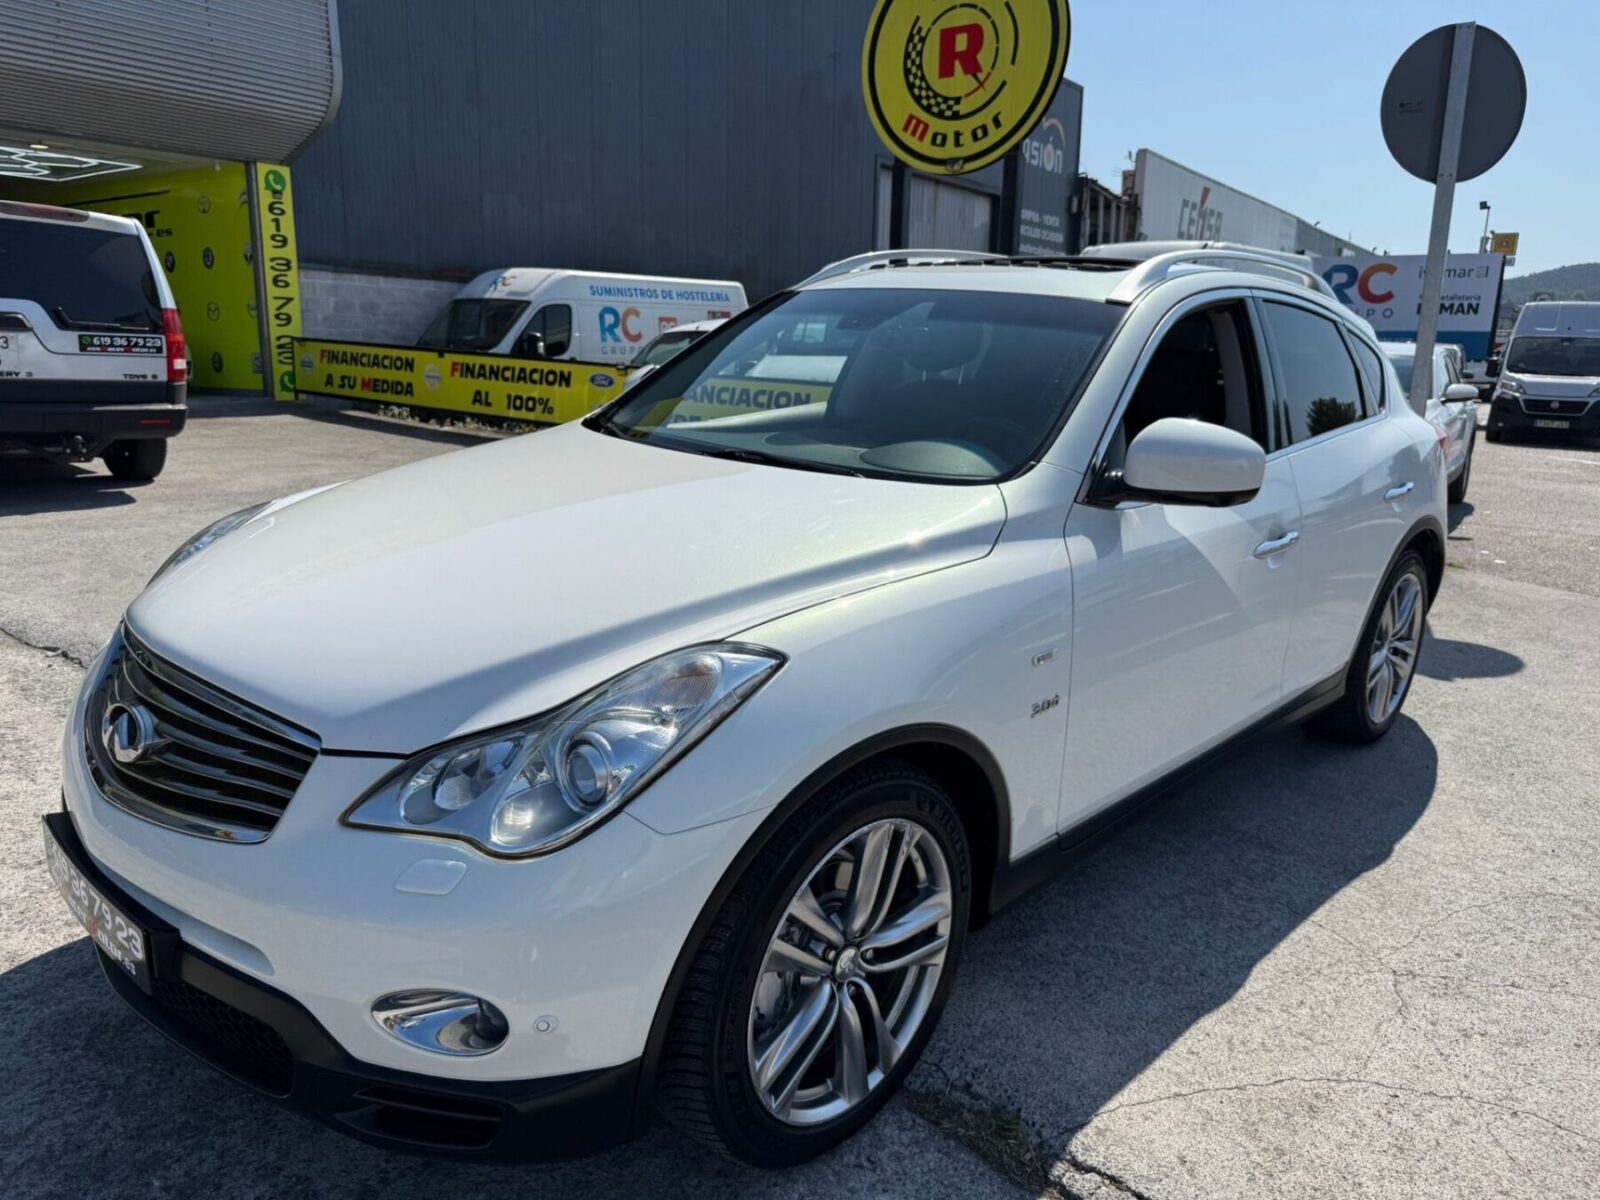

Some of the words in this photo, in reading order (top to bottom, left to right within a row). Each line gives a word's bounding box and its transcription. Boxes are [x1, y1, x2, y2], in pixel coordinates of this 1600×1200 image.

[938, 22, 984, 79] R
[589, 285, 659, 299] SUMINISTROS
[661, 290, 674, 299] DE
[598, 306, 643, 343] RC
[319, 349, 415, 373] FINANCIACION
[325, 373, 334, 388] A
[338, 375, 357, 389] SU
[361, 377, 414, 397] MEDIDA
[450, 361, 572, 388] FINANCIACION
[472, 390, 492, 407] AL
[506, 394, 554, 415] 100%
